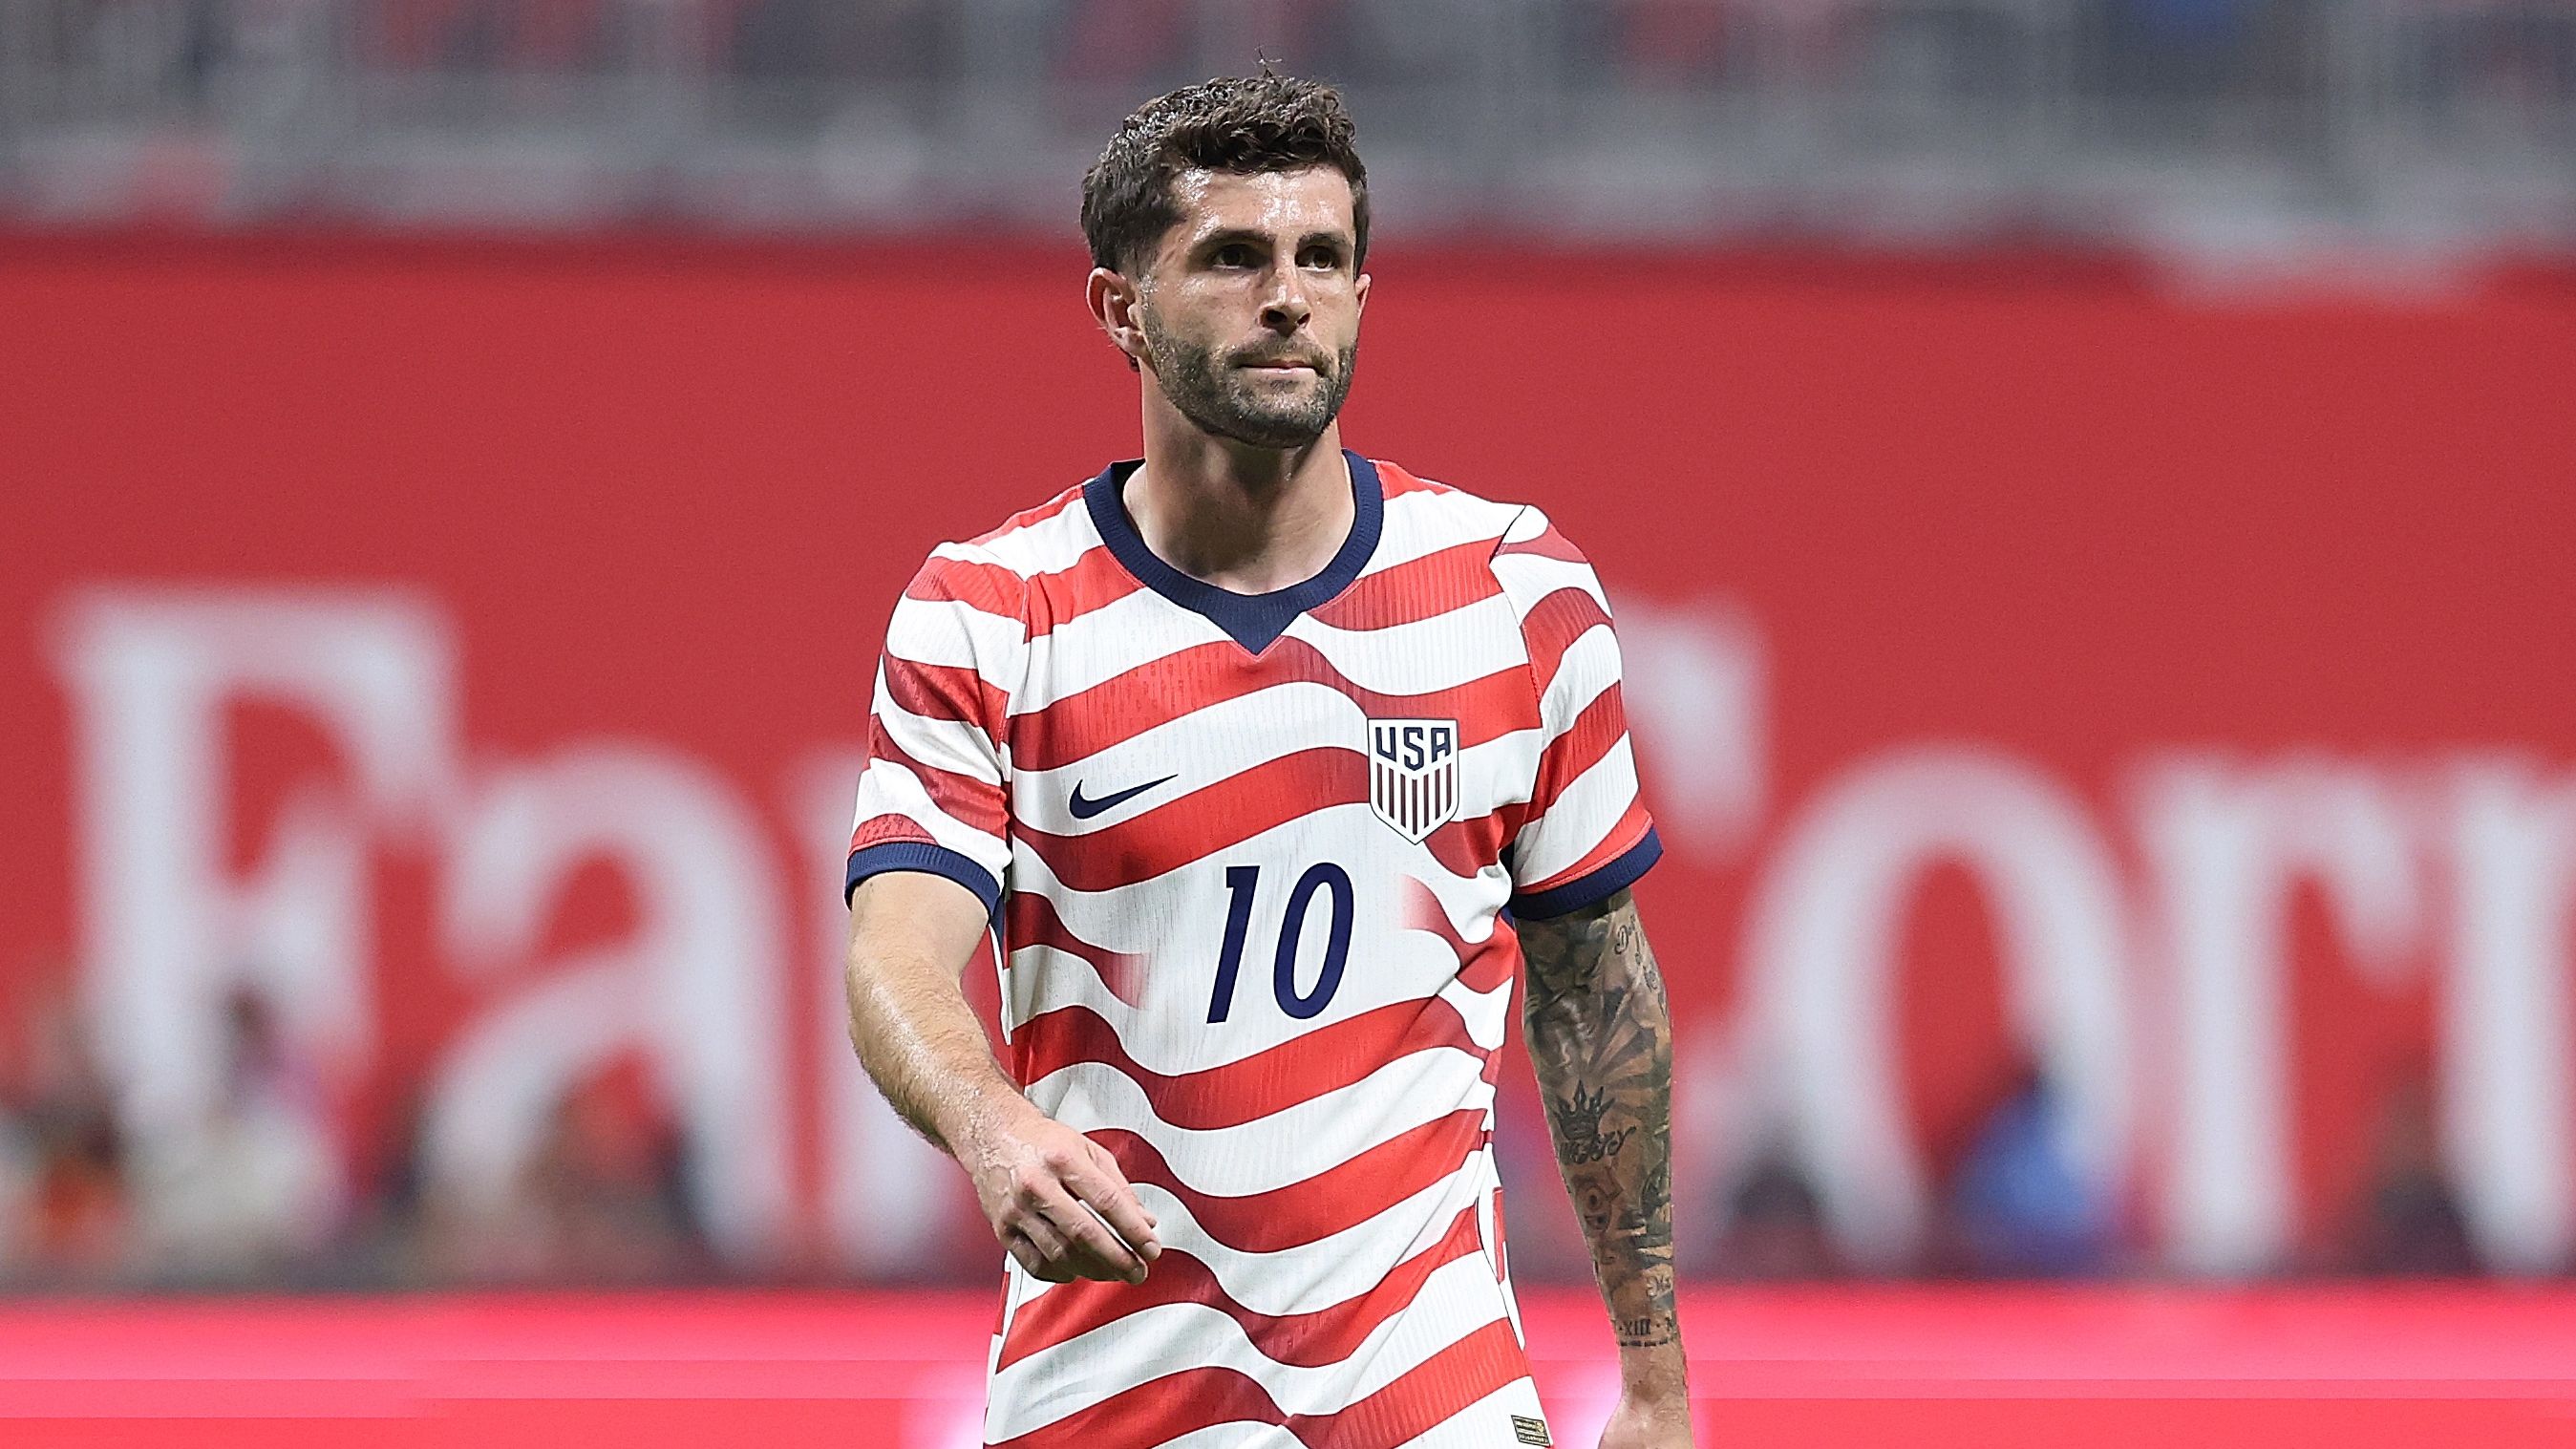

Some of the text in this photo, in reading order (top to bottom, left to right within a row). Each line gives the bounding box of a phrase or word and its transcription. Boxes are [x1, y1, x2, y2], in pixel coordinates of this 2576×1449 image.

[1374, 726, 1452, 772] USA
[57, 587, 955, 1275] Fa
[1206, 862, 1354, 1024] 10
